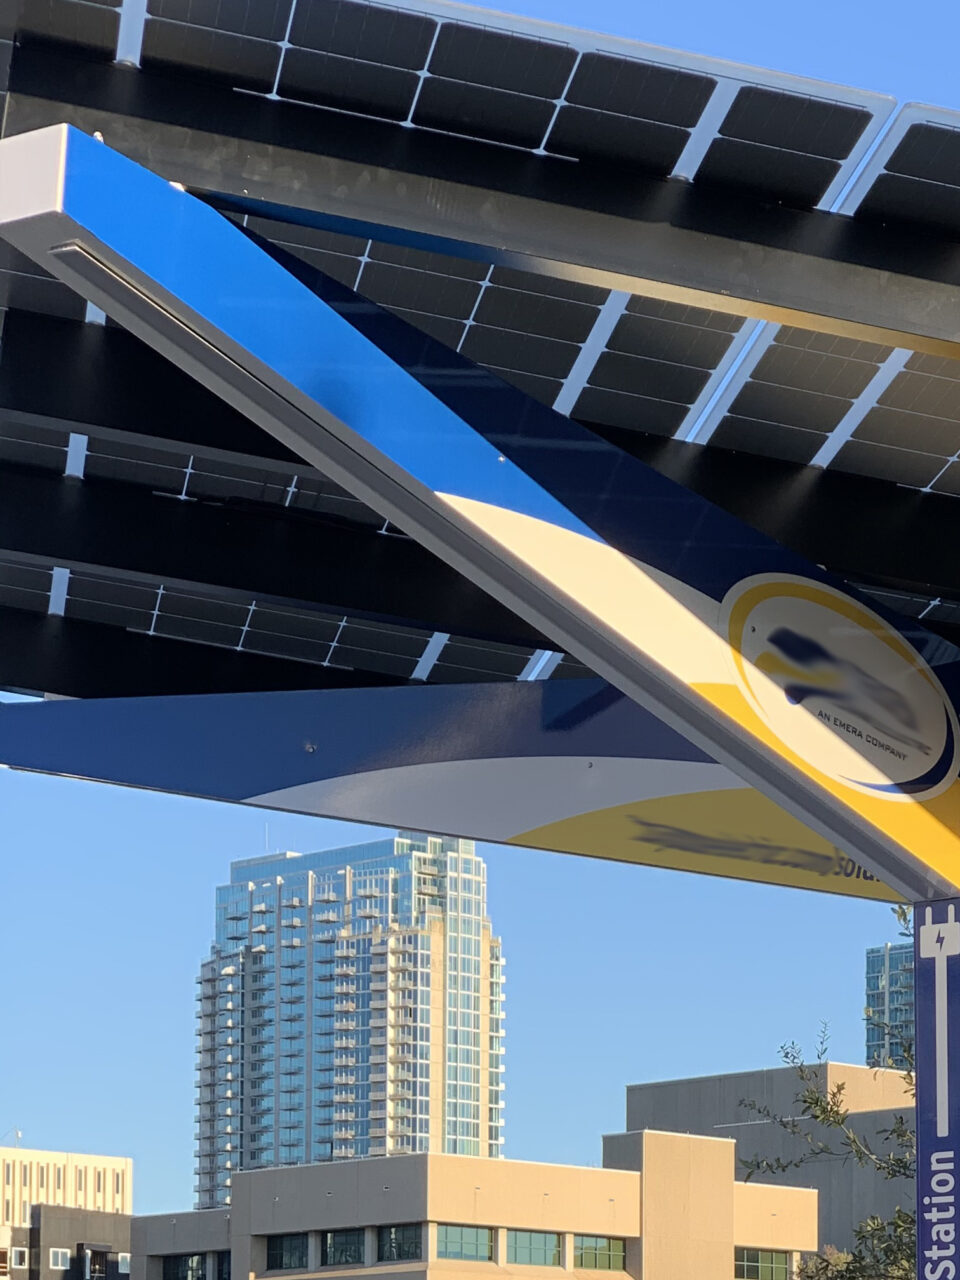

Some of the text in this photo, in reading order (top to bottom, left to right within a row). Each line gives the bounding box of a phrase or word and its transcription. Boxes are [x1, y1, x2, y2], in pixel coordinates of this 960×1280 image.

[817, 709, 909, 762] AN EMERA COMPANY
